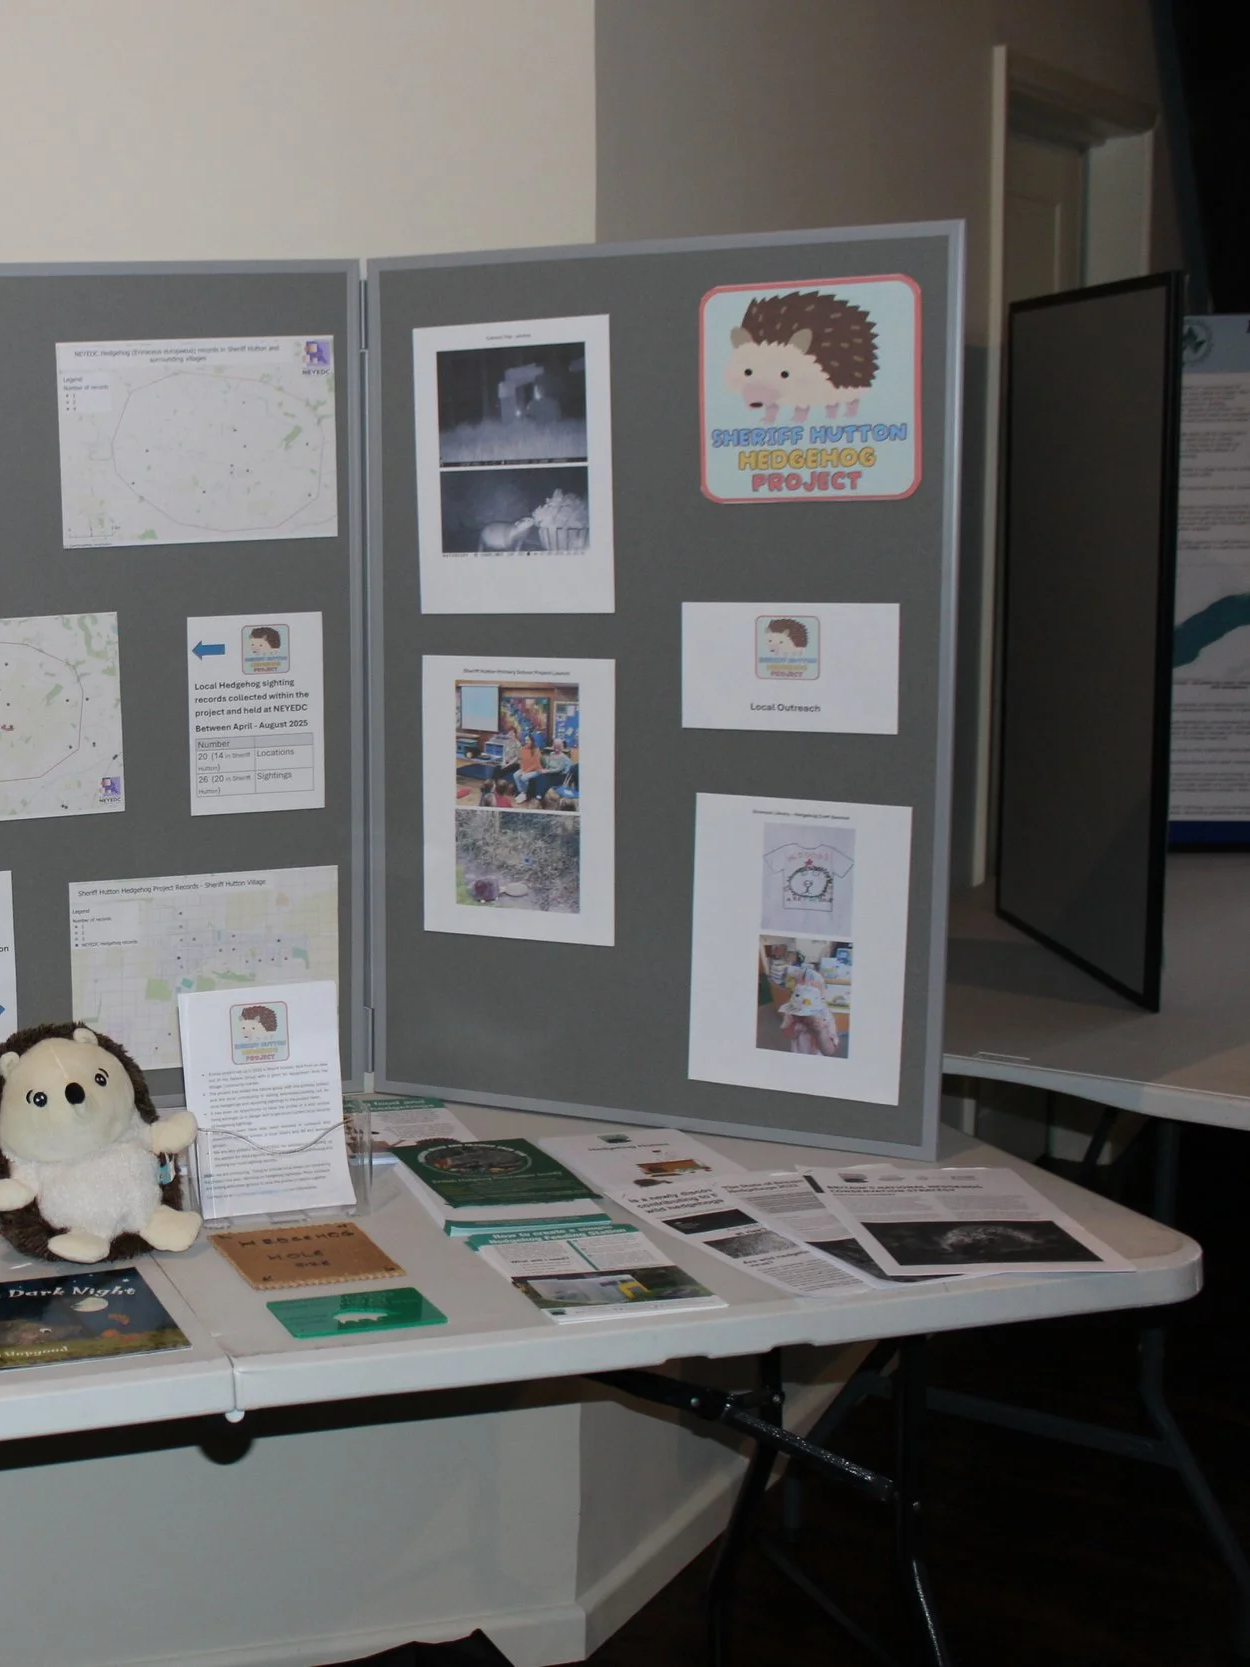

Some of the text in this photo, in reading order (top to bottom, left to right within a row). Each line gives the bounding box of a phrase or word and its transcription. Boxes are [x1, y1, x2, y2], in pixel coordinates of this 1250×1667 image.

[711, 423, 907, 448] SHERIFF HUTTON
[738, 447, 876, 470] HEDGEHOG
[752, 471, 862, 492] PROJECT
[219, 681, 260, 689] Hedgehog
[262, 679, 294, 687] sighting
[195, 691, 309, 704] records collected within the
[195, 709, 224, 718] project
[244, 706, 261, 714] held
[273, 704, 307, 712] NEYEDC
[750, 703, 820, 713] Local Outreach
[233, 722, 252, 731] April
[259, 721, 287, 730] August
[198, 741, 229, 749] Number
[257, 749, 294, 757] Locations
[257, 772, 292, 780] Sightings
[121, 887, 151, 895] Hedgehog
[153, 885, 173, 893] Project
[268, 1250, 324, 1260] HOLE
[8, 1286, 65, 1298] Dark
[72, 1285, 136, 1297] Night
